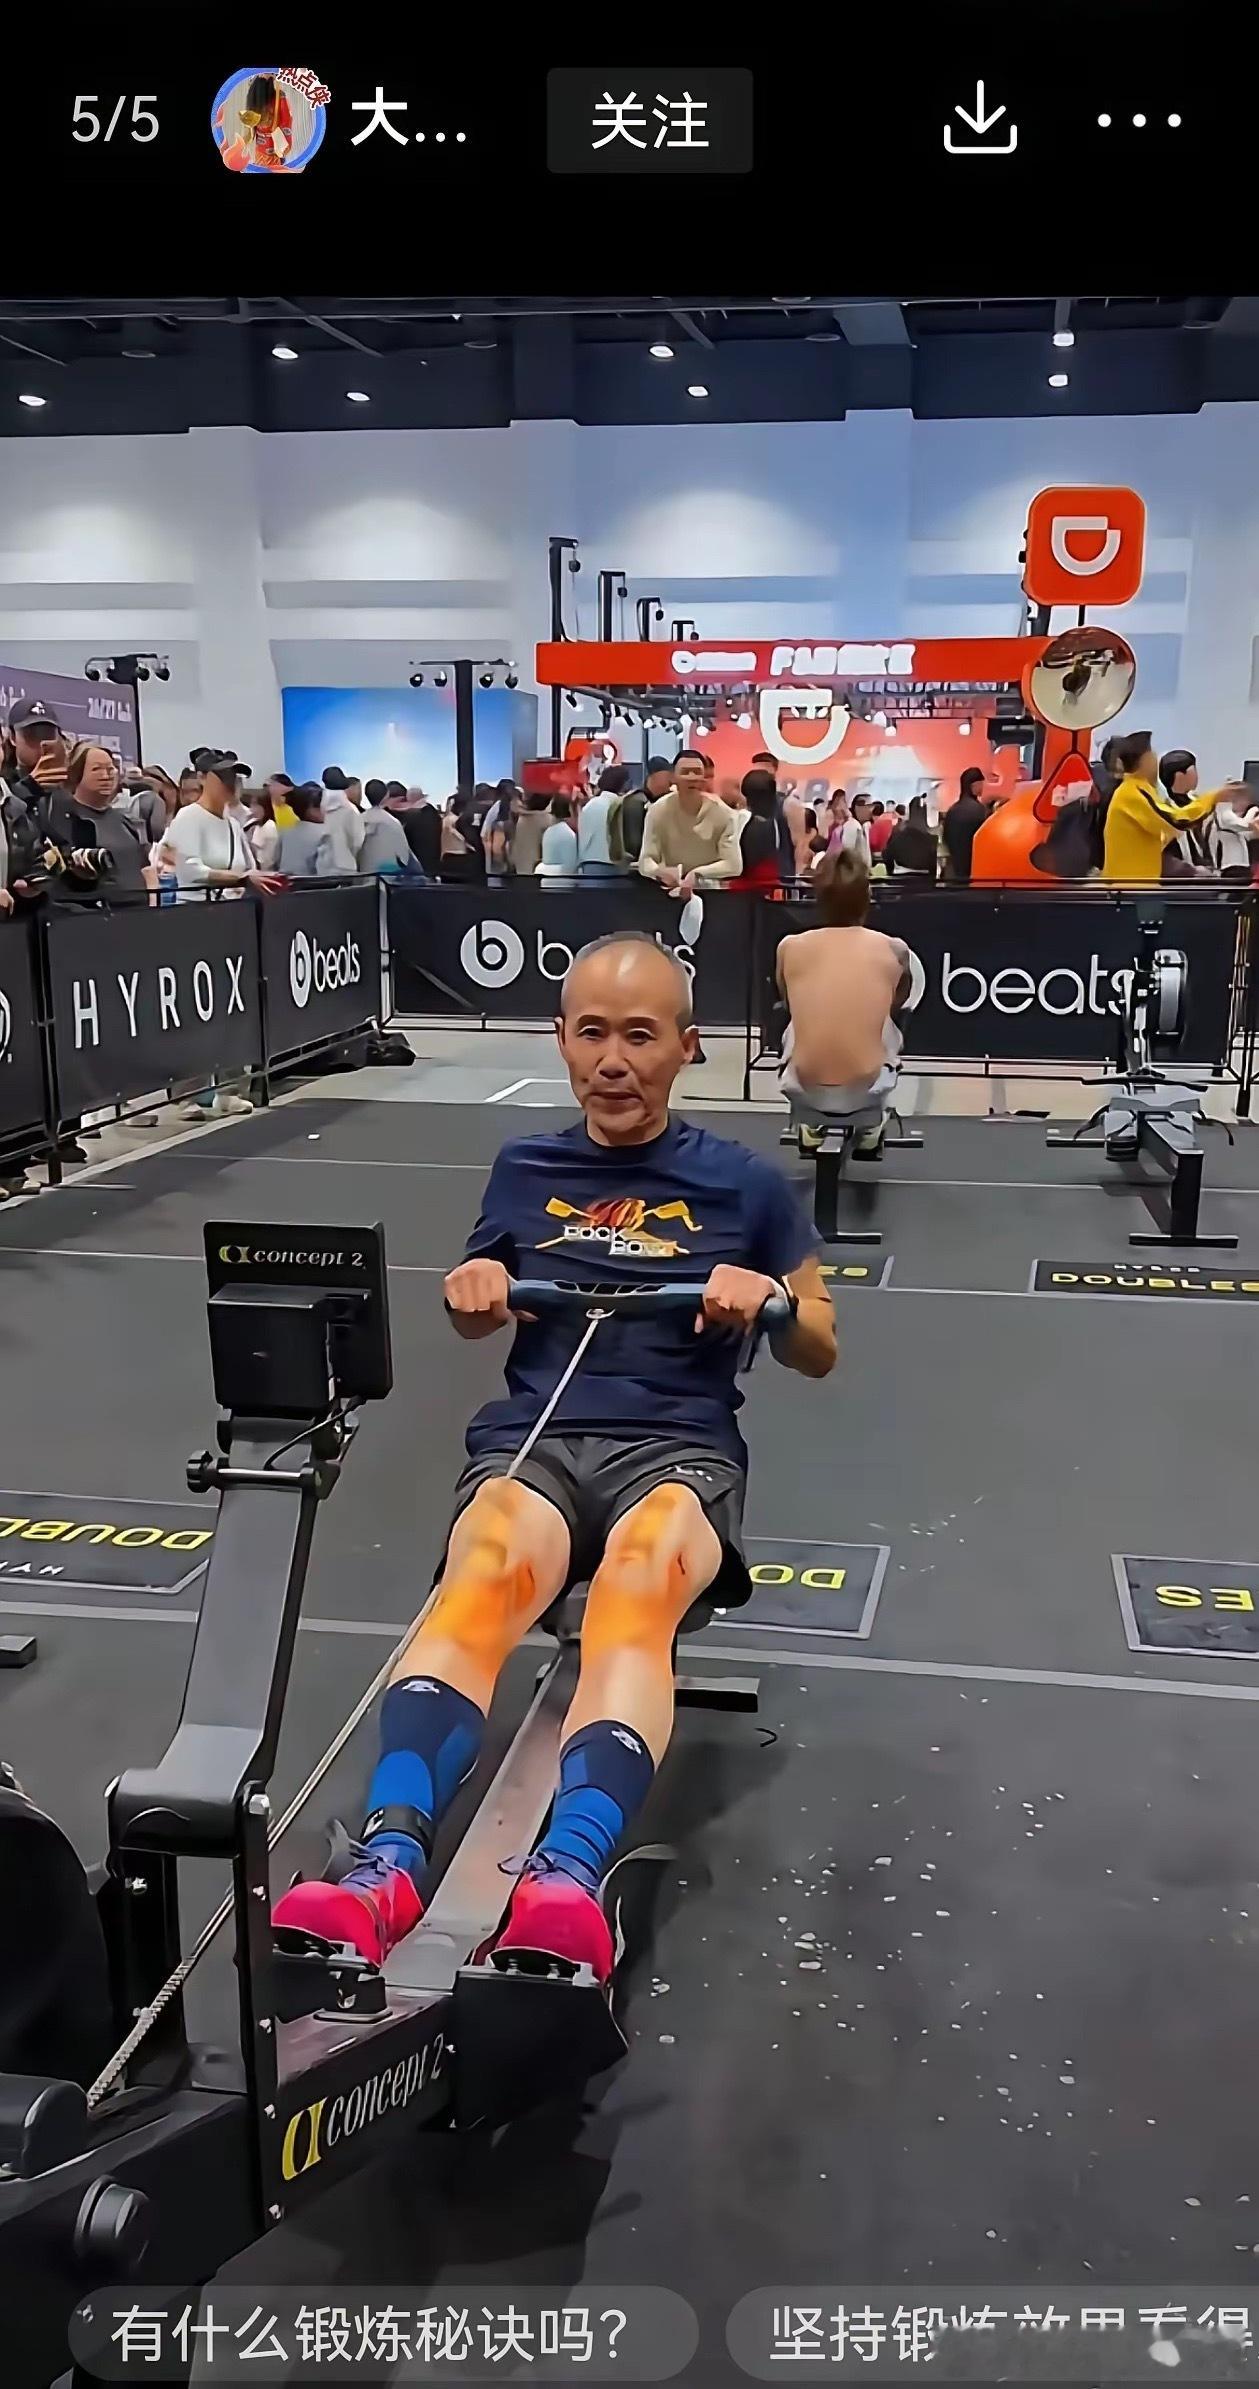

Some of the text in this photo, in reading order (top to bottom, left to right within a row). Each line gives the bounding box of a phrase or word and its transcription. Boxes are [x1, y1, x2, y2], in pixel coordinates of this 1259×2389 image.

[312, 931, 361, 993] beats
[73, 955, 245, 1049] HYROX
[254, 1249, 364, 1267] concept 2
[326, 2032, 444, 2147] concept 2
